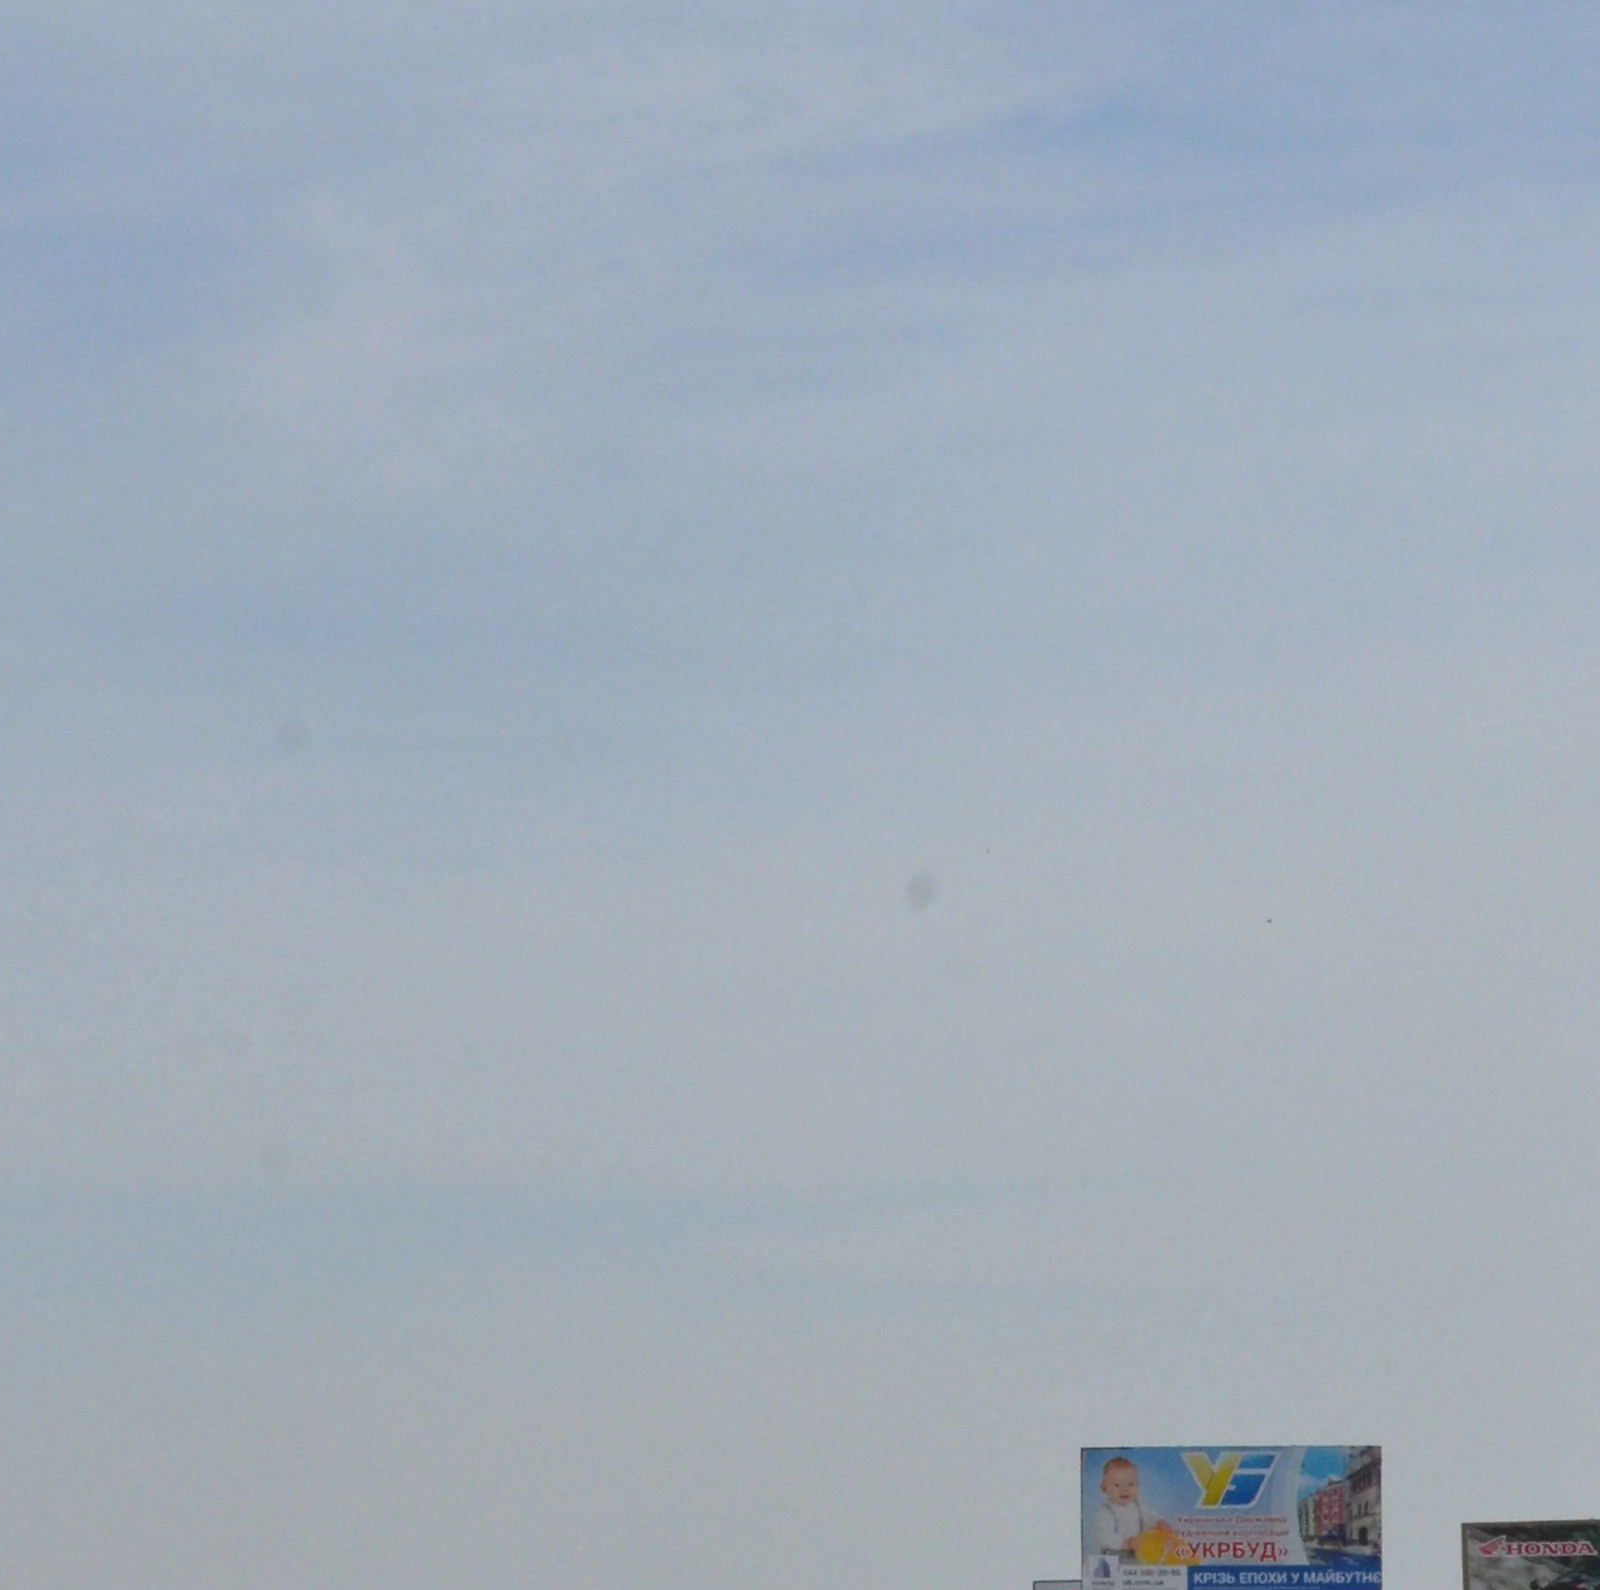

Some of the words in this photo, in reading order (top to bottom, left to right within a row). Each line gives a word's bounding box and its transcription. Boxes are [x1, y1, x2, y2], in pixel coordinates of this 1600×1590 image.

[1175, 1541, 1288, 1561] «УКРБУД»
[1505, 1541, 1598, 1557] HONDA
[1193, 1571, 1236, 1585] КРІЗЬ
[1239, 1570, 1287, 1585] ЕПОХИ
[1289, 1570, 1302, 1584] У
[1303, 1569, 1381, 1585] МАЙБУТНЄ
